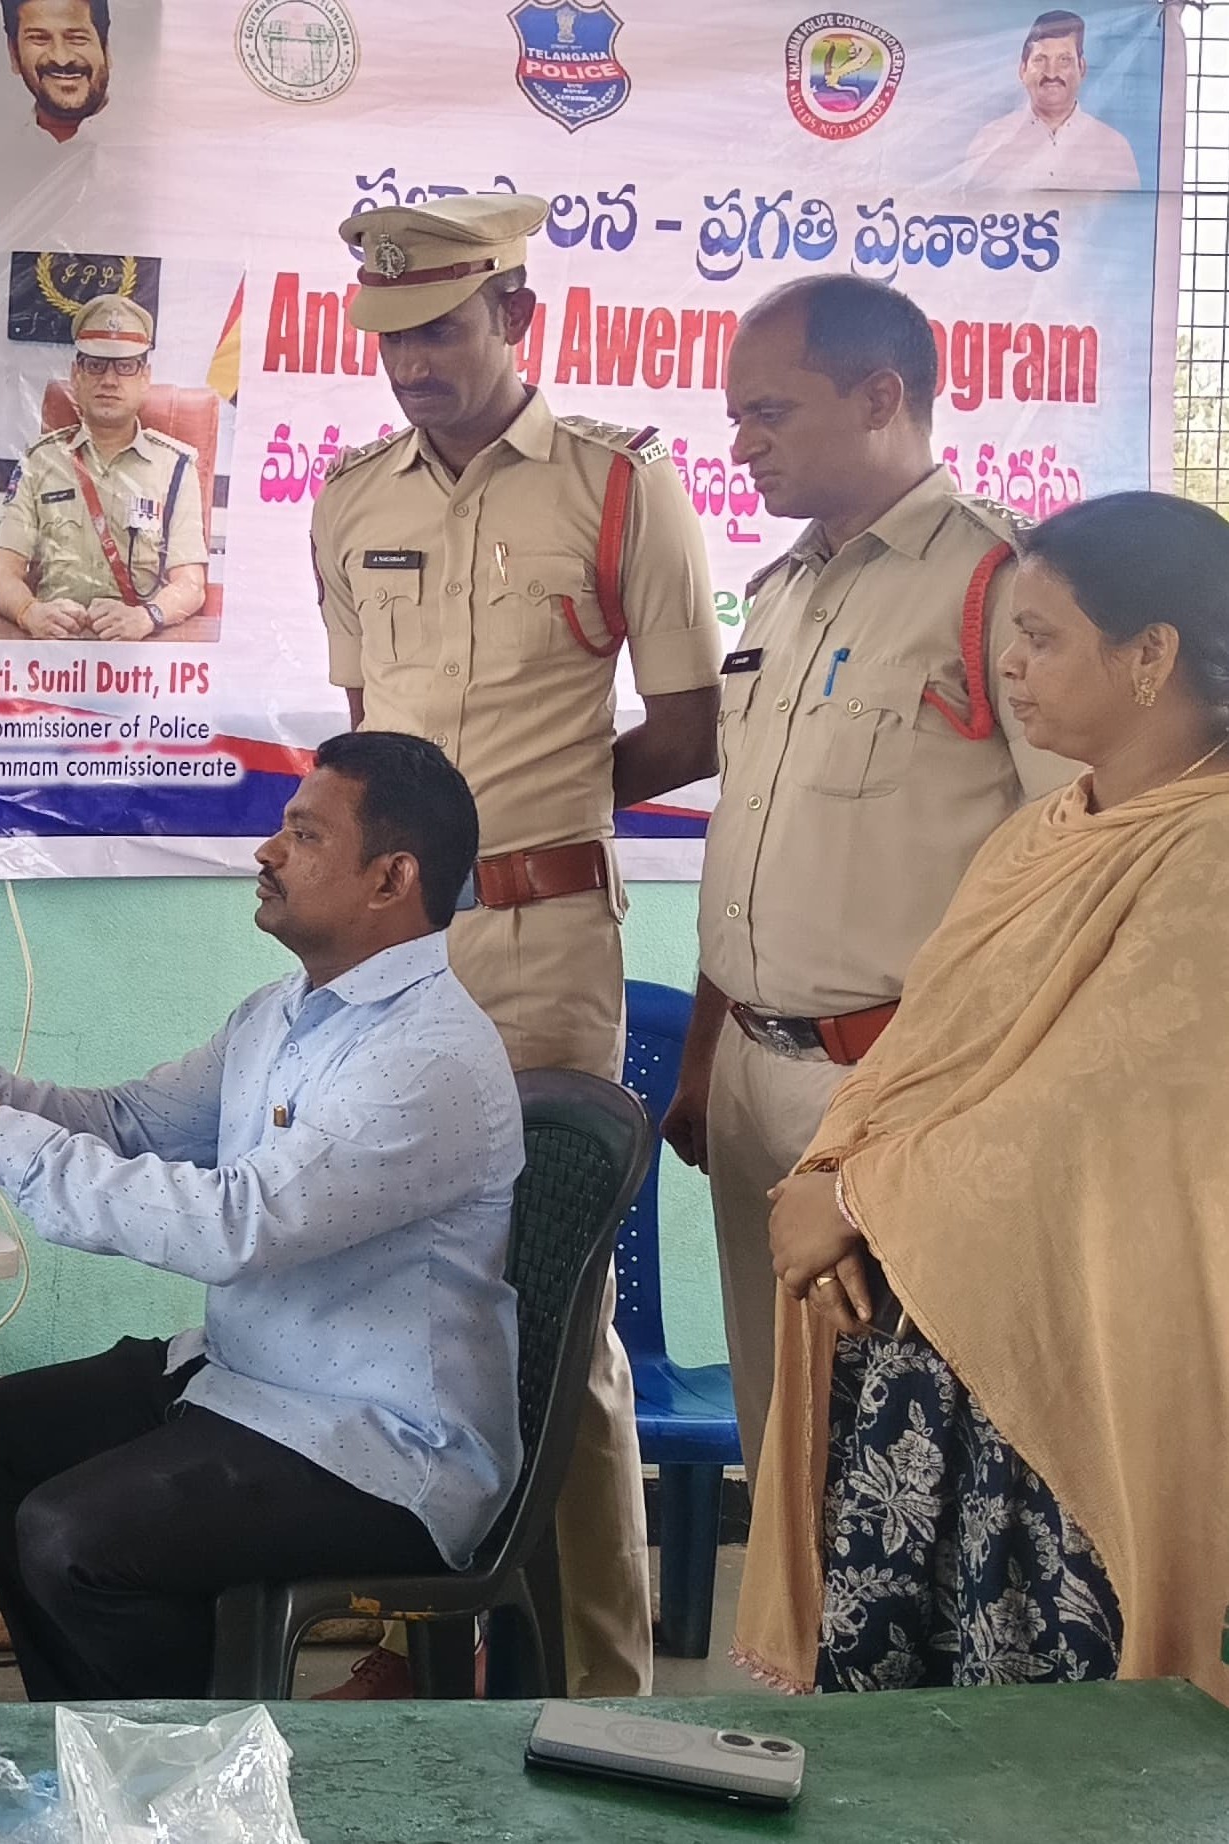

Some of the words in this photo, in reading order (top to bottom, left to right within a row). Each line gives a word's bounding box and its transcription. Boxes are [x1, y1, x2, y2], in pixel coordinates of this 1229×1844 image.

[527, 47, 609, 61] TELANGANA
[800, 16, 834, 36] POLICE
[836, 16, 904, 89] COMMISSIONERATE
[526, 60, 619, 80] POLICE
[791, 92, 817, 128] DEEDS
[821, 125, 846, 135] NOT
[849, 100, 886, 132] WORDS
[696, 188, 838, 281] ప్రగతి
[27, 659, 87, 693] Sunil
[96, 661, 159, 699] Dutt,
[169, 662, 209, 694] IPS
[119, 715, 140, 739] of
[150, 715, 210, 739] Police
[66, 754, 237, 777] commissionerate
